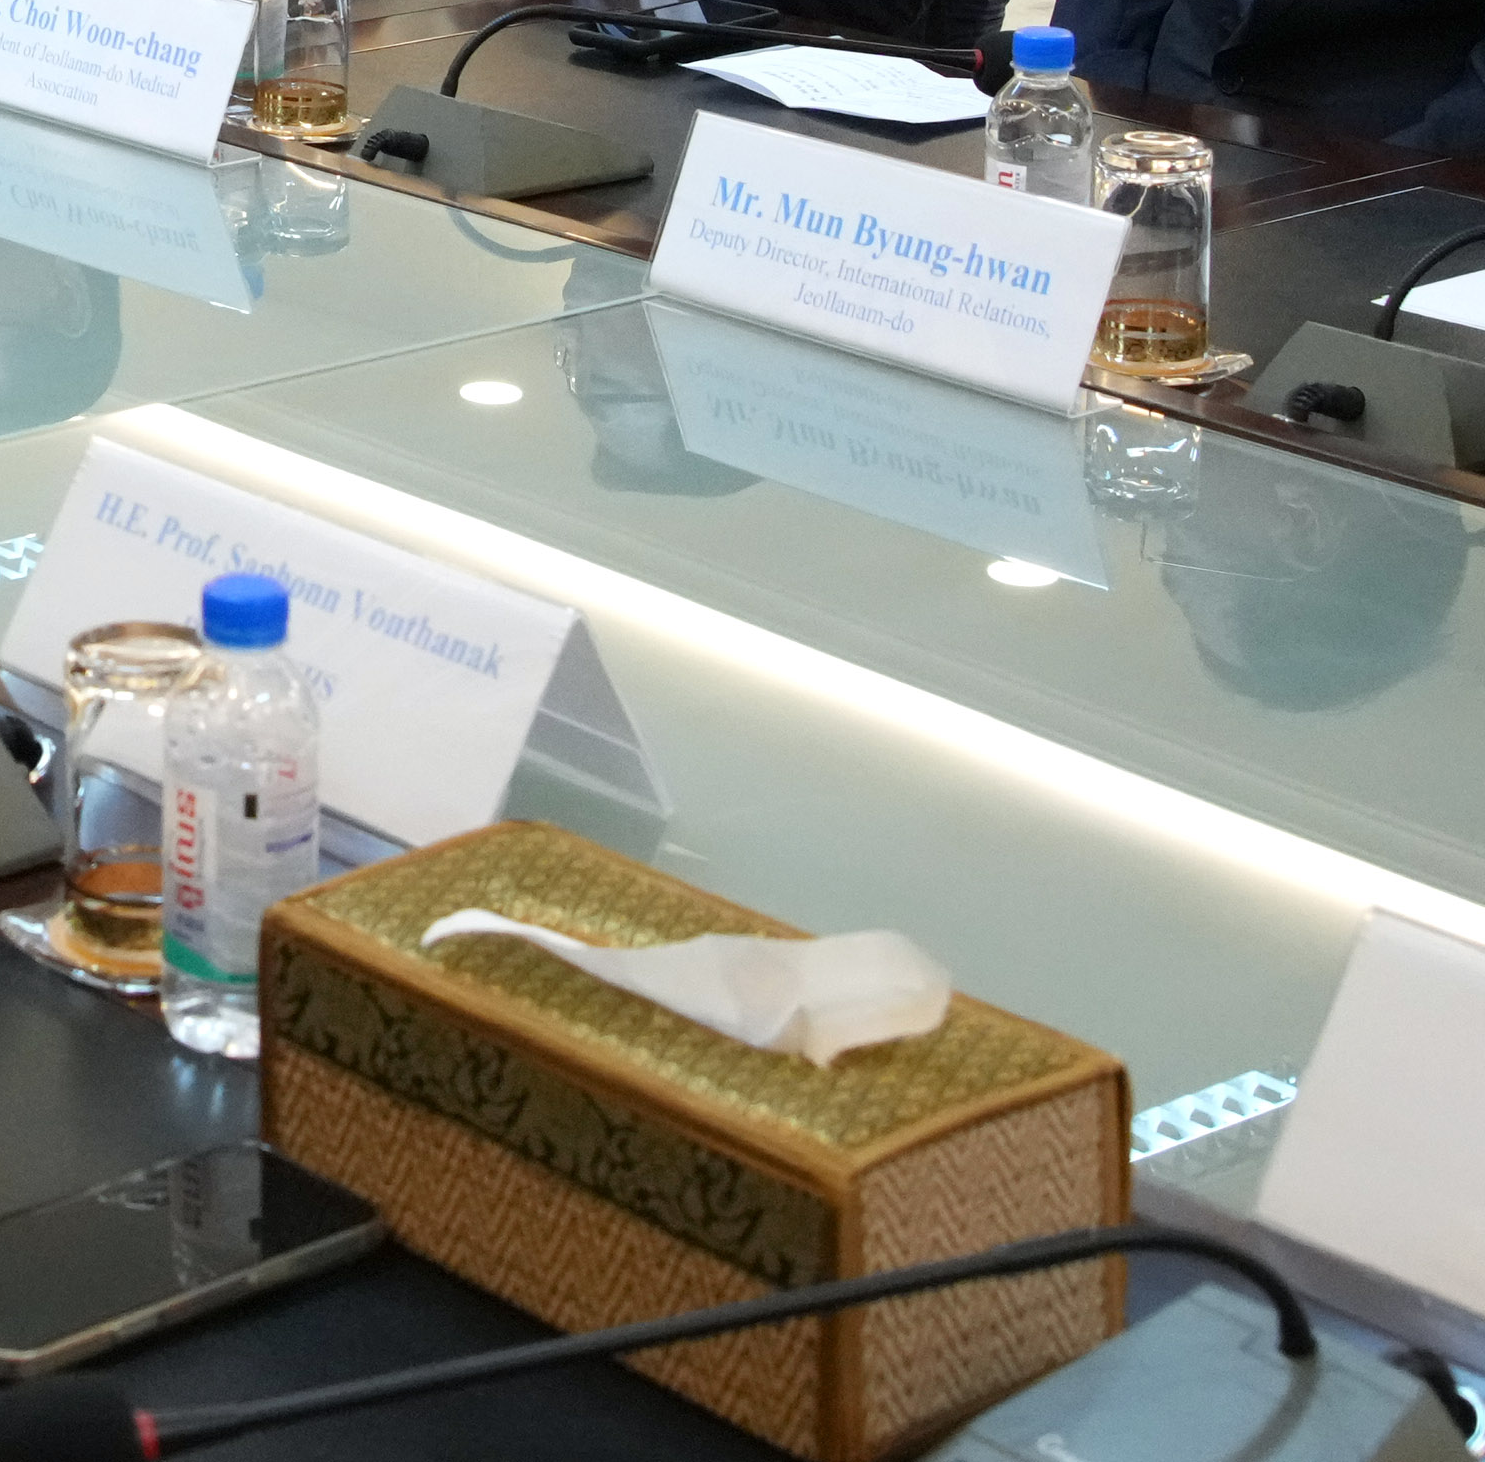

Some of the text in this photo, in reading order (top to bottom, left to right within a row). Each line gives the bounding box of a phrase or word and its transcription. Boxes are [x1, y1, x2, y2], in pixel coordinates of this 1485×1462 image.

[23, 39, 38, 57] of
[37, 42, 123, 83] Jeollanam-do
[125, 68, 181, 100] Medical
[65, 8, 202, 77] Woon-chang
[25, 72, 98, 106] Association
[711, 176, 1052, 295] Mr. Mun Byung-hwan
[689, 219, 1051, 339] Deputy Director, International Relations,
[794, 283, 914, 334] Jeollanam-do
[97, 492, 148, 538] H.E.
[156, 516, 220, 566] Prof.
[346, 587, 506, 680] Vonthanak
